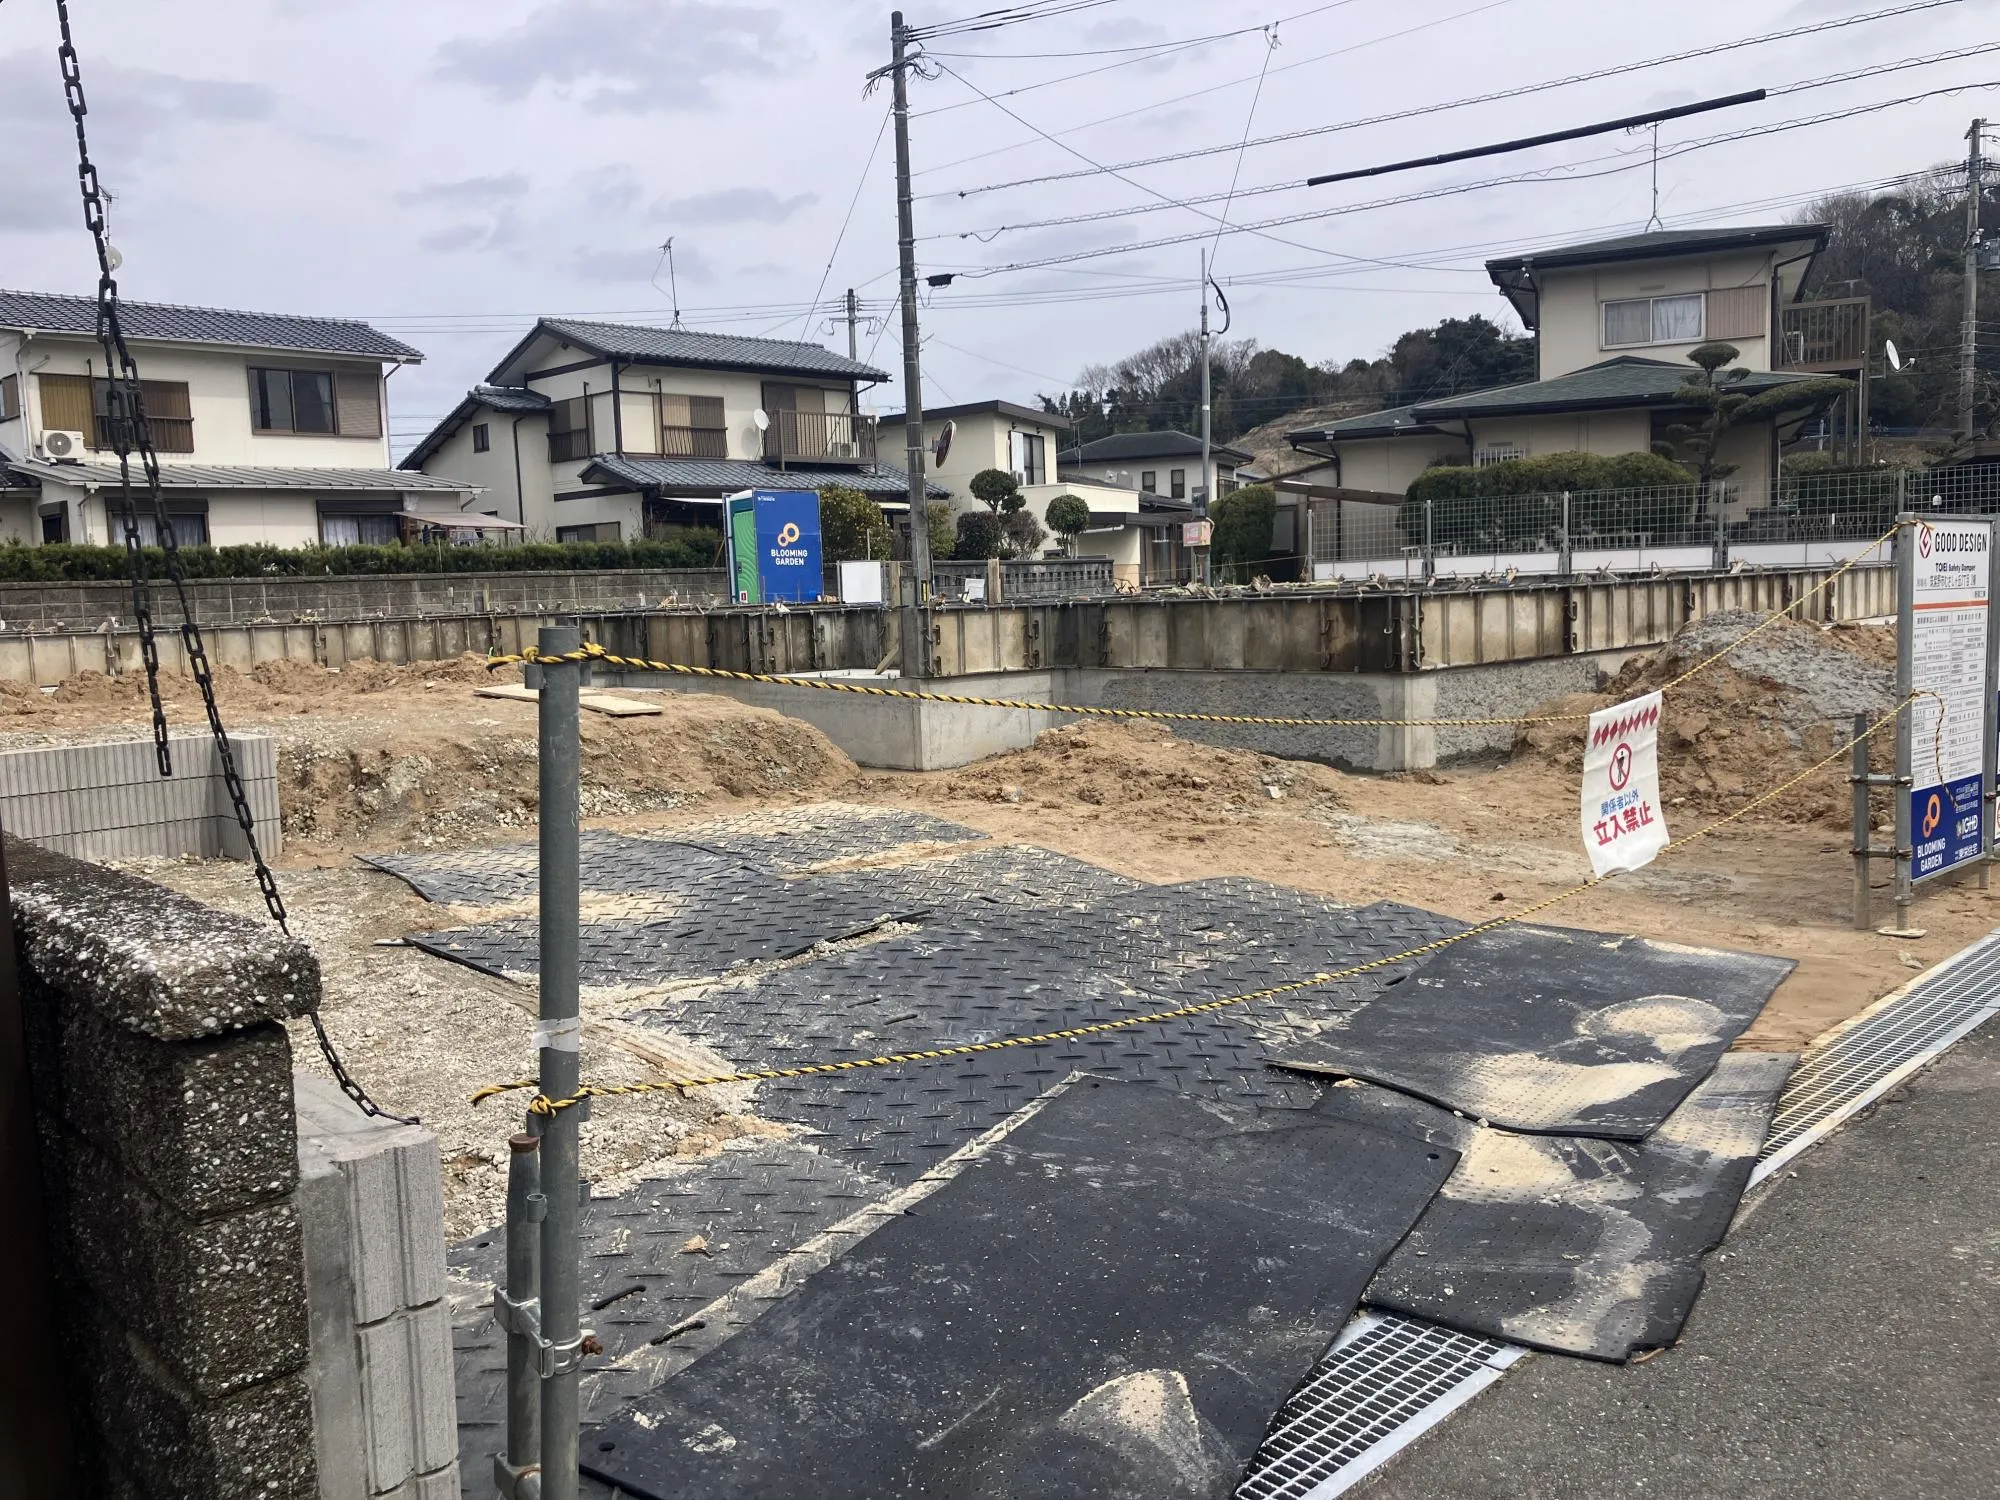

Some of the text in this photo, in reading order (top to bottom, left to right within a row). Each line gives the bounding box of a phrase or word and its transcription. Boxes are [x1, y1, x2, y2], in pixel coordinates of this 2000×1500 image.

[1935, 533, 1987, 552] GOOD DESIGN
[771, 549, 808, 557] BLOOMING
[775, 557, 804, 565] GARDEN
[1601, 789, 1639, 817] 関係者以外
[1593, 800, 1654, 846] 立入禁止
[1917, 838, 1945, 858] BLOOMING
[1920, 853, 1943, 872] GARDEN
